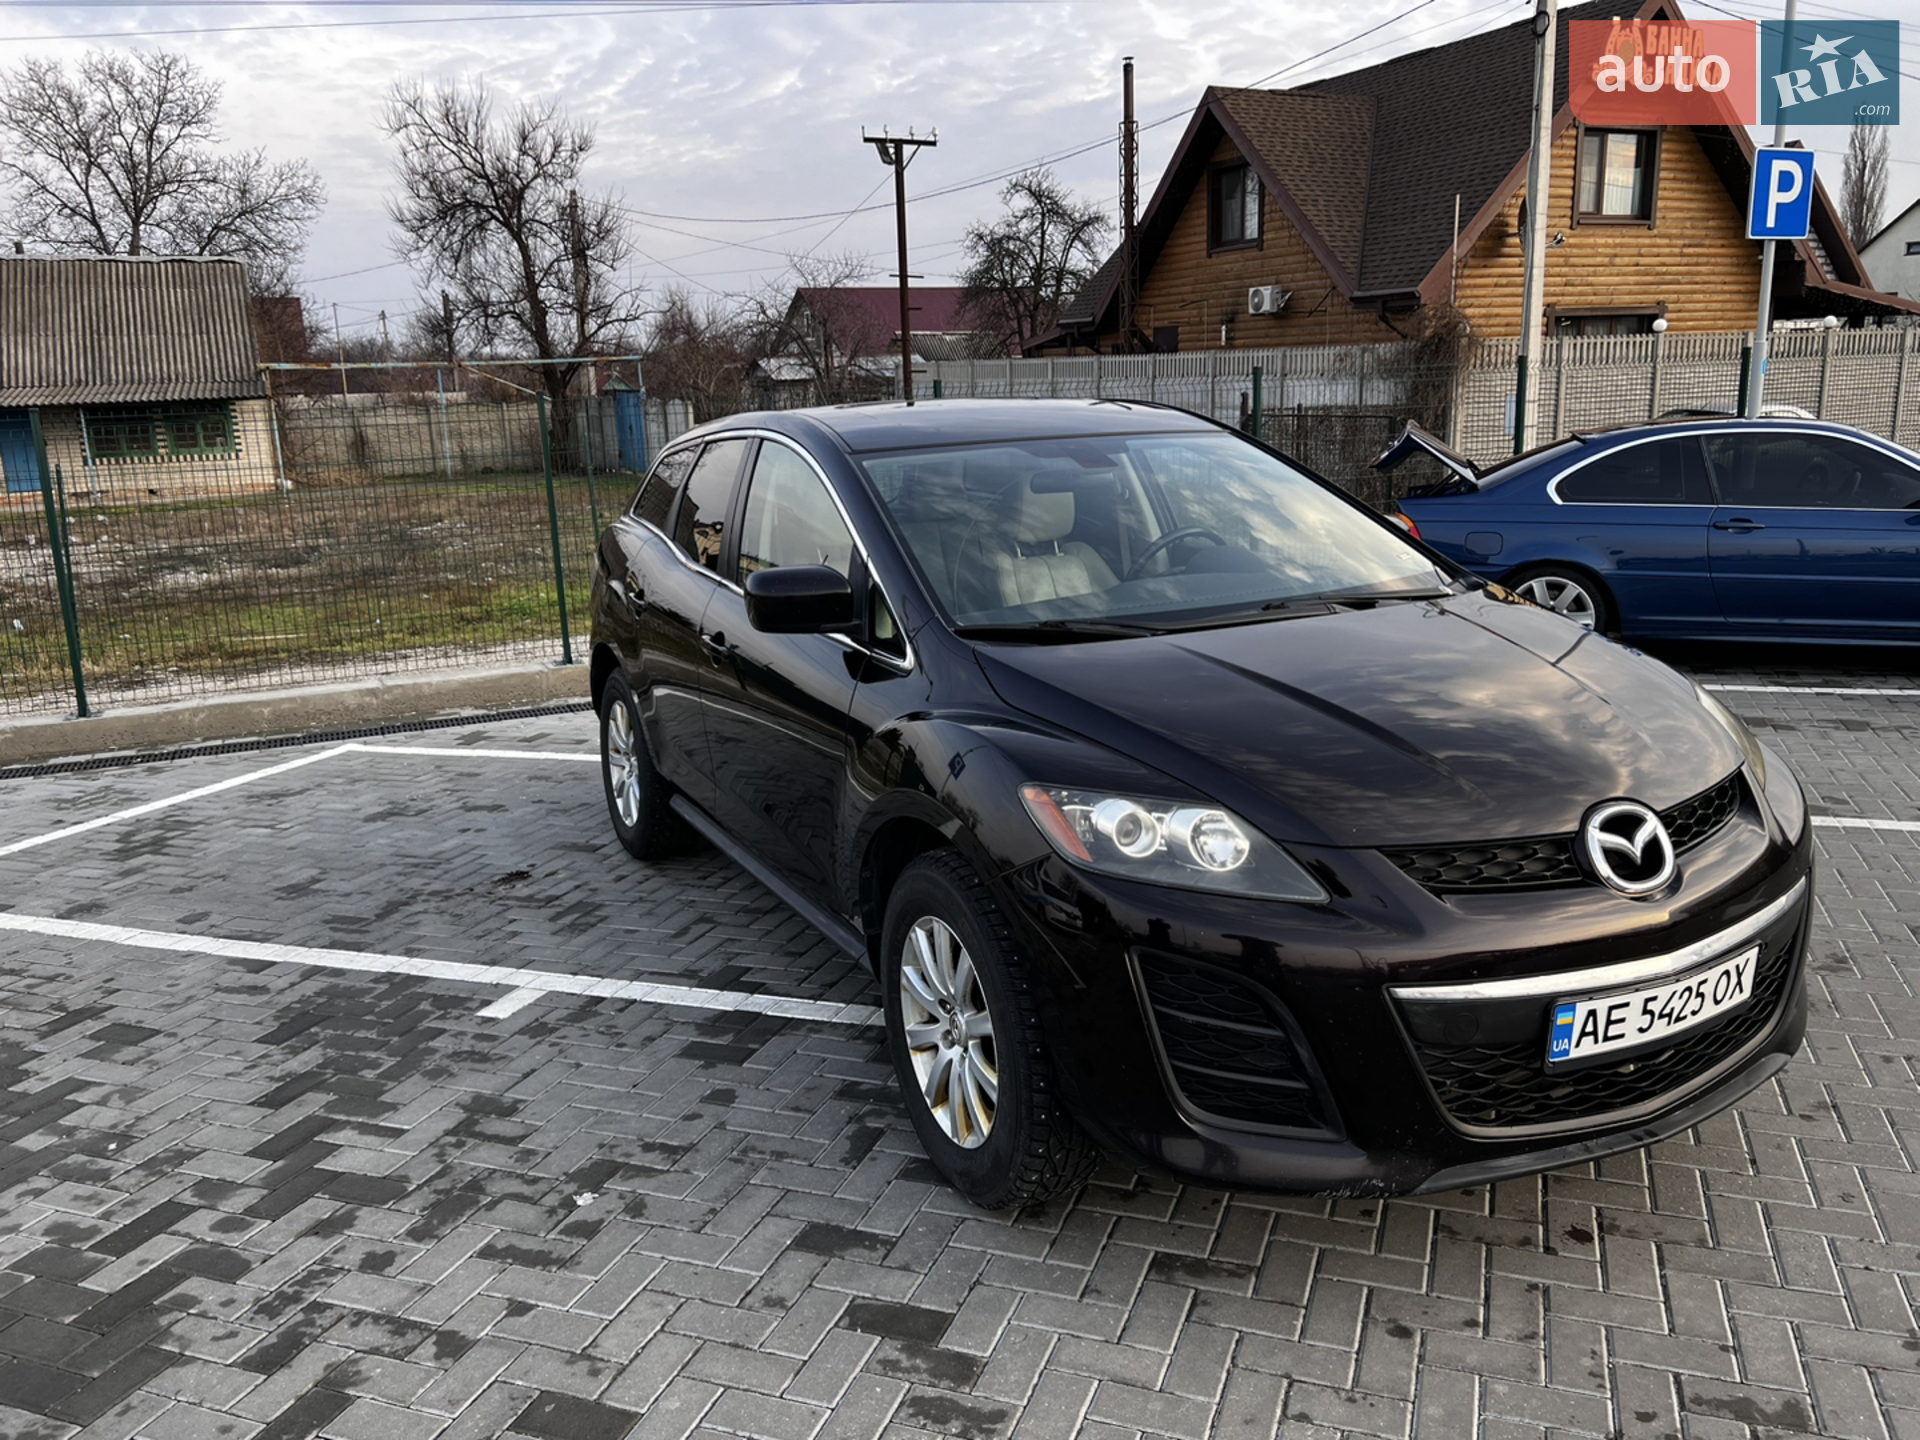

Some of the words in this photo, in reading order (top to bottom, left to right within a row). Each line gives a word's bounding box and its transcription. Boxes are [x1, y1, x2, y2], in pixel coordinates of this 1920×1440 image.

[1766, 159, 1804, 229] P
[1574, 1001, 1631, 1049] AE
[1636, 978, 1709, 1034] 5425
[1712, 957, 1751, 1006] OX
[1553, 1038, 1570, 1053] UA
